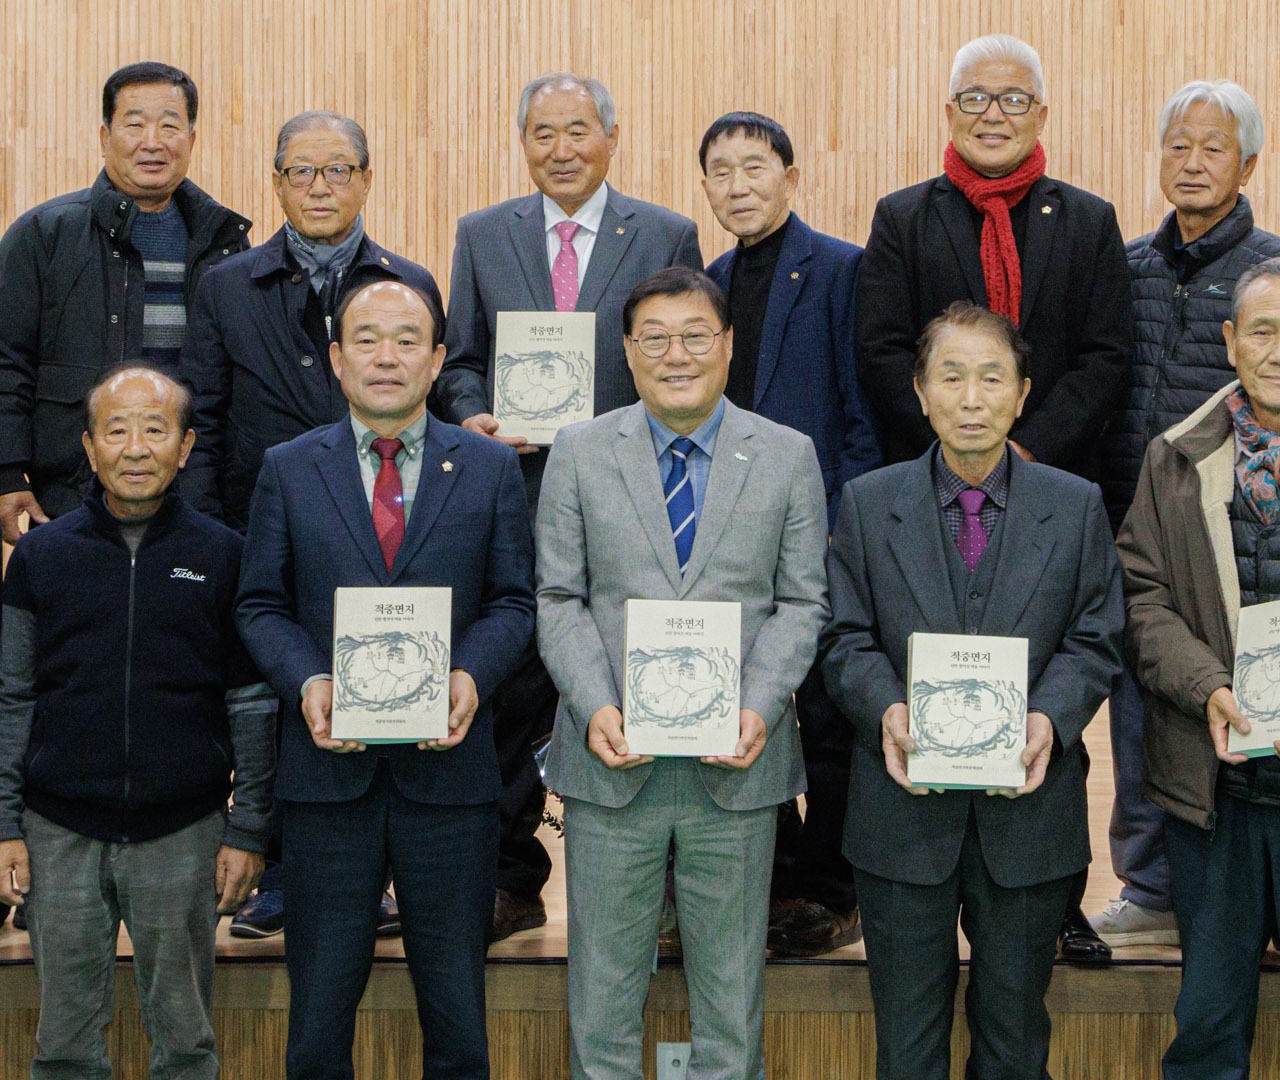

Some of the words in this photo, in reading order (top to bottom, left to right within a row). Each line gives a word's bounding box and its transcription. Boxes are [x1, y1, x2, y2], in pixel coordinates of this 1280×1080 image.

[529, 325, 564, 337] 적중면지
[170, 567, 207, 582] Titleist
[375, 603, 415, 615] 적중면지
[665, 617, 705, 630] 적중면지
[950, 650, 991, 664] 적중면지
